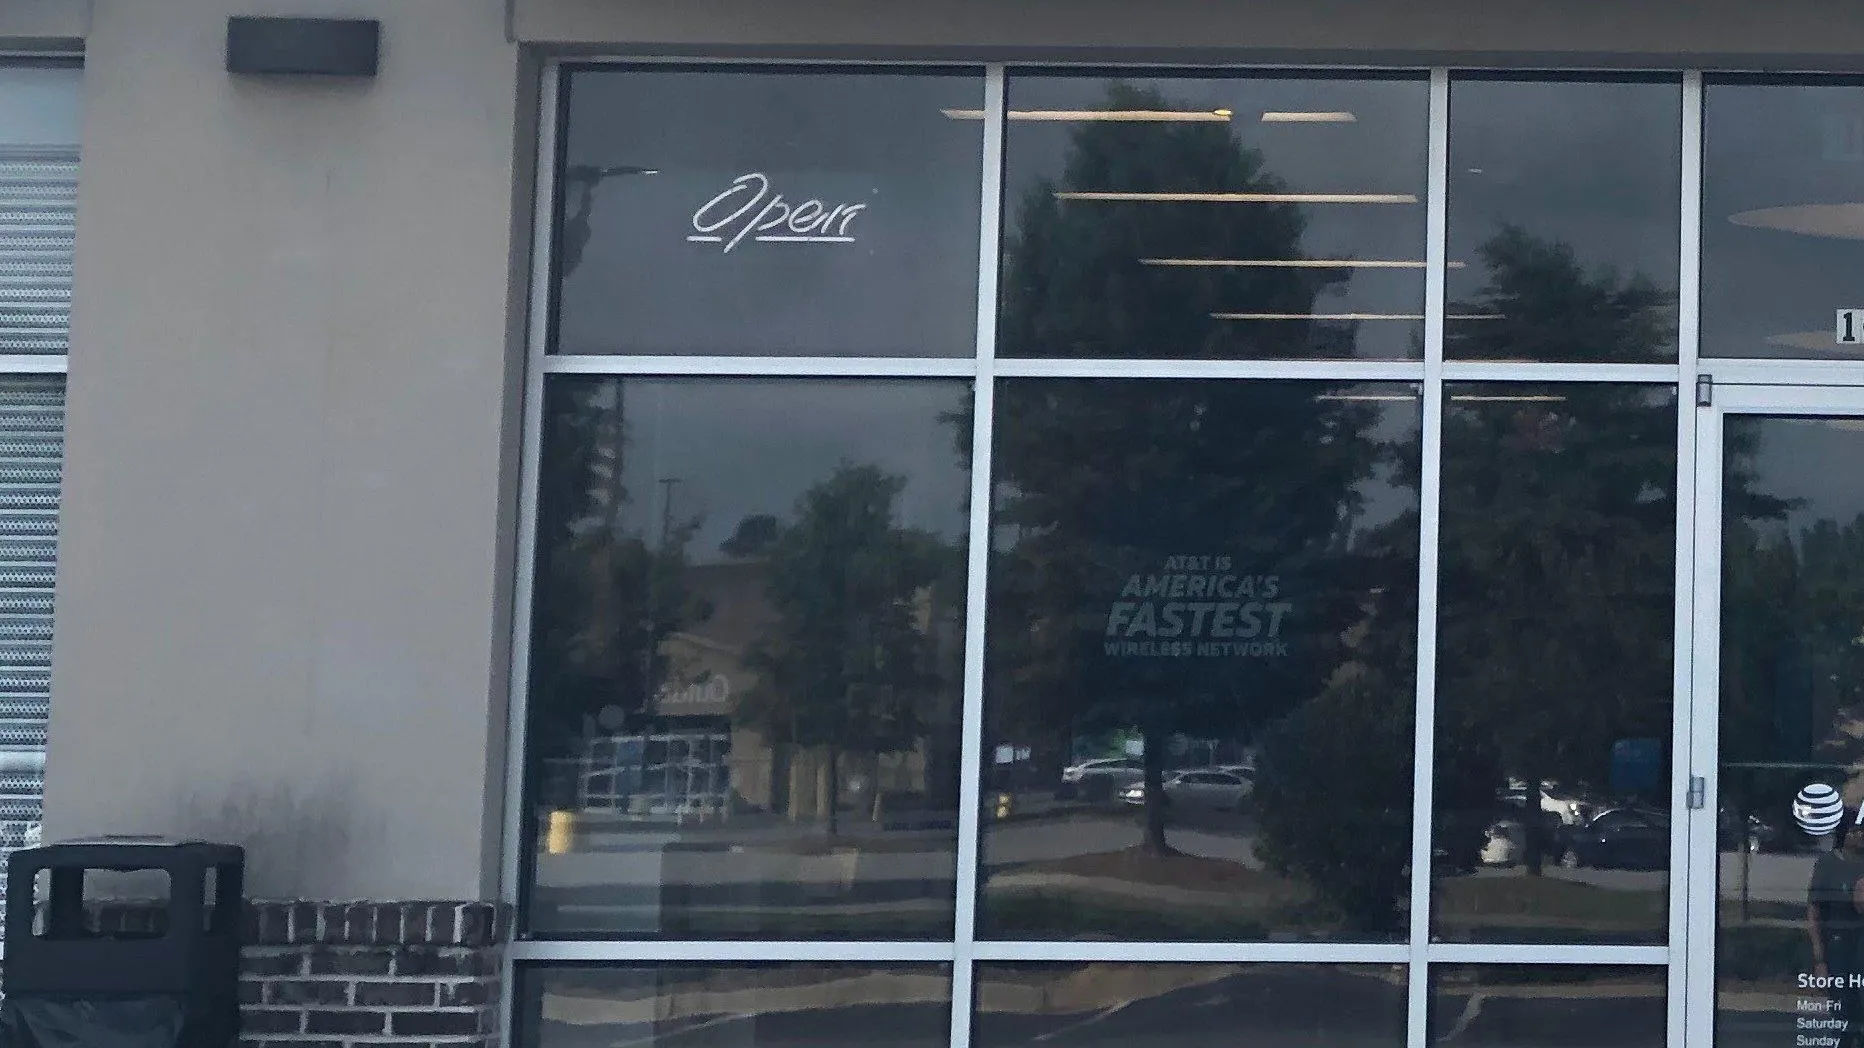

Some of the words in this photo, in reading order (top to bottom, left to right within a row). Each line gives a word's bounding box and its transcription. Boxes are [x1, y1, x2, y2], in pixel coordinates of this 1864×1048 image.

[688, 172, 867, 253] Open
[1163, 554, 1211, 571] AT&T
[1214, 554, 1233, 571] IS
[1120, 573, 1281, 599] AMERICA'S
[1105, 601, 1293, 639] FASTEST
[1103, 641, 1193, 657] WIRELESS
[1197, 641, 1289, 657] NETWORK
[1797, 973, 1845, 989] Store
[1796, 1017, 1849, 1032] Saturday
[1796, 1034, 1841, 1048] Sunday
